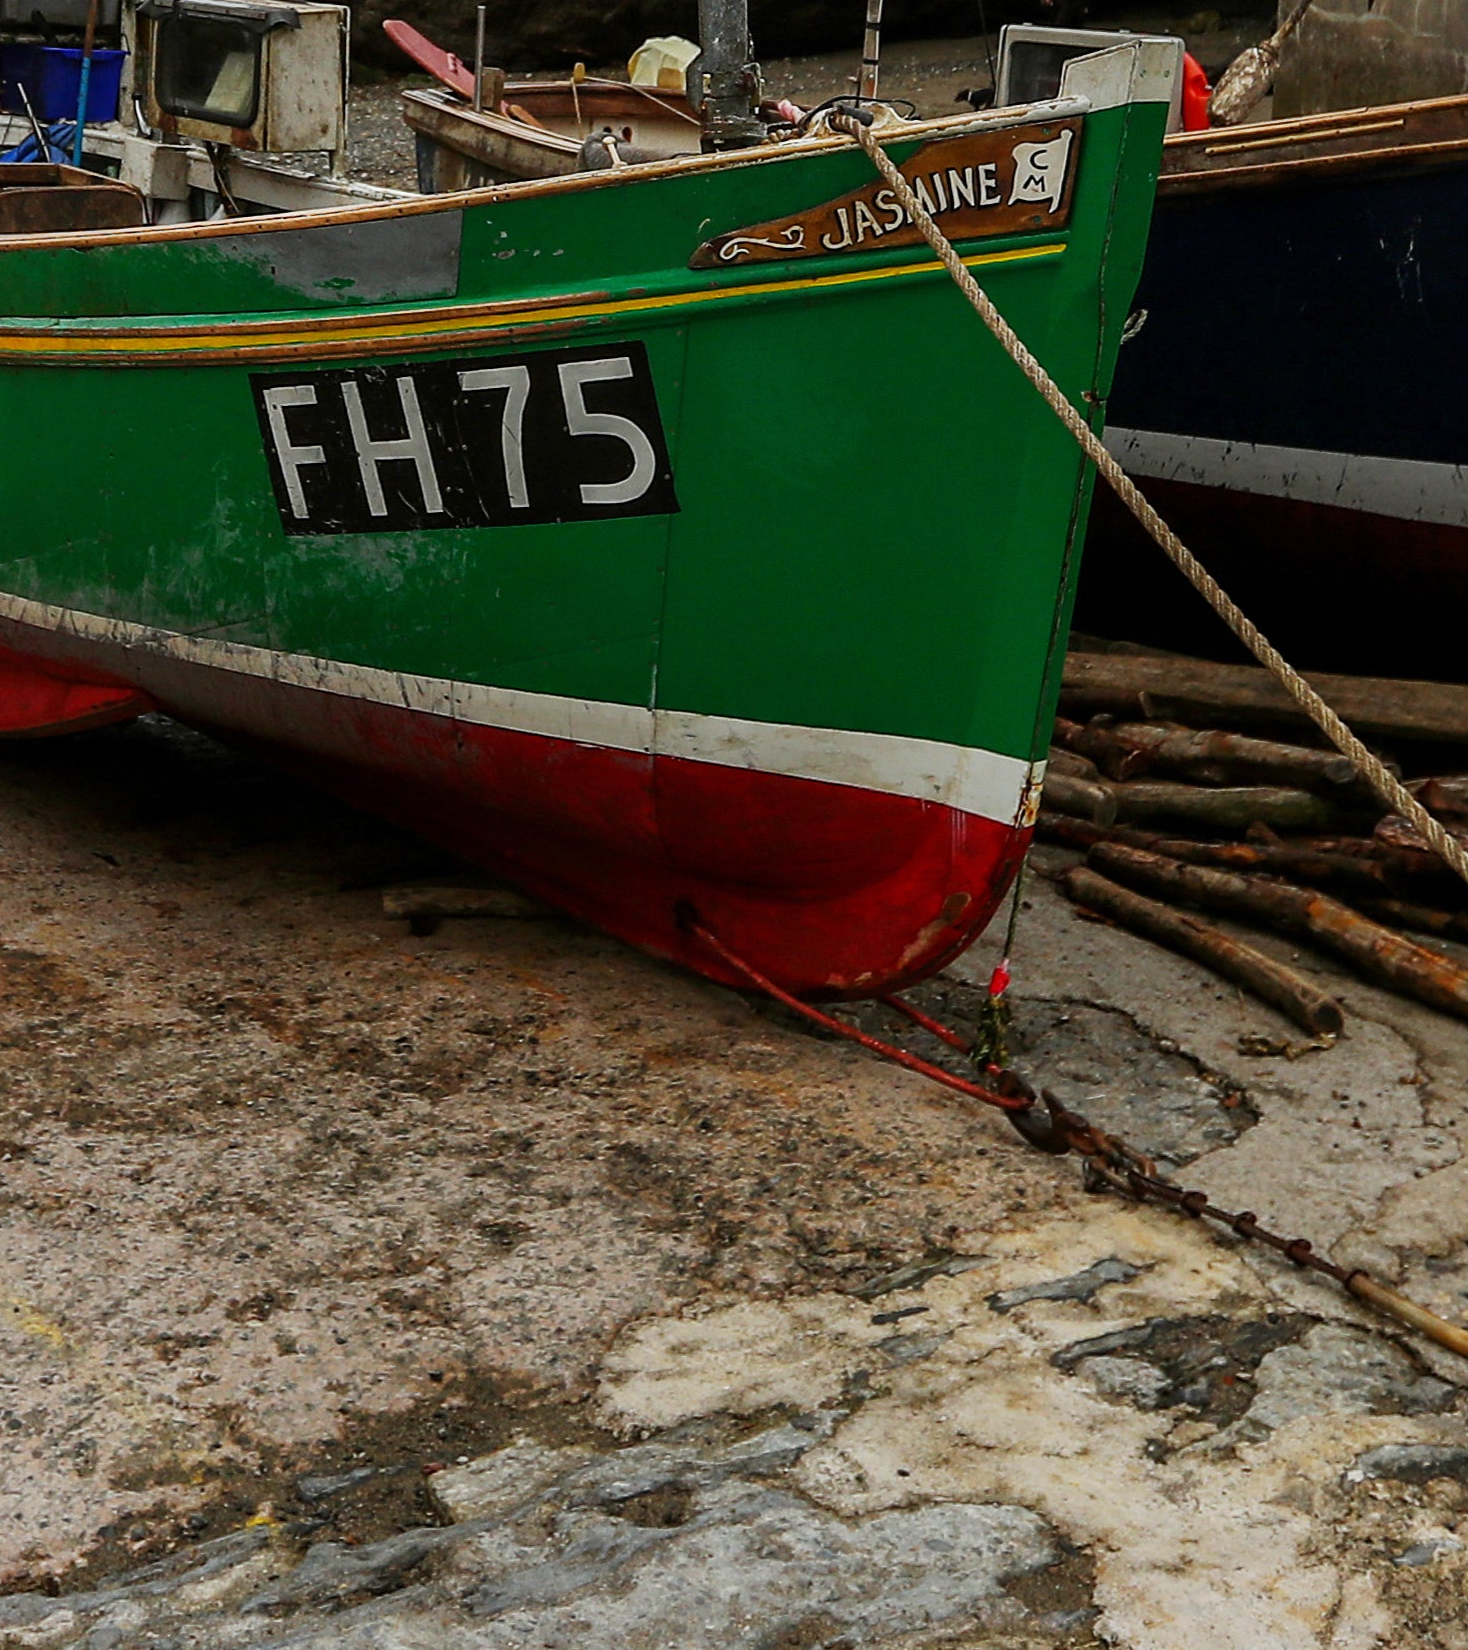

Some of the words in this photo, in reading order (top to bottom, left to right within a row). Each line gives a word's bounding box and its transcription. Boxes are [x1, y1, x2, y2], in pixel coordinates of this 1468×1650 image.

[1030, 150, 1049, 170] C
[1022, 175, 1045, 192] M
[263, 376, 443, 519] FH
[457, 357, 656, 508] 75
